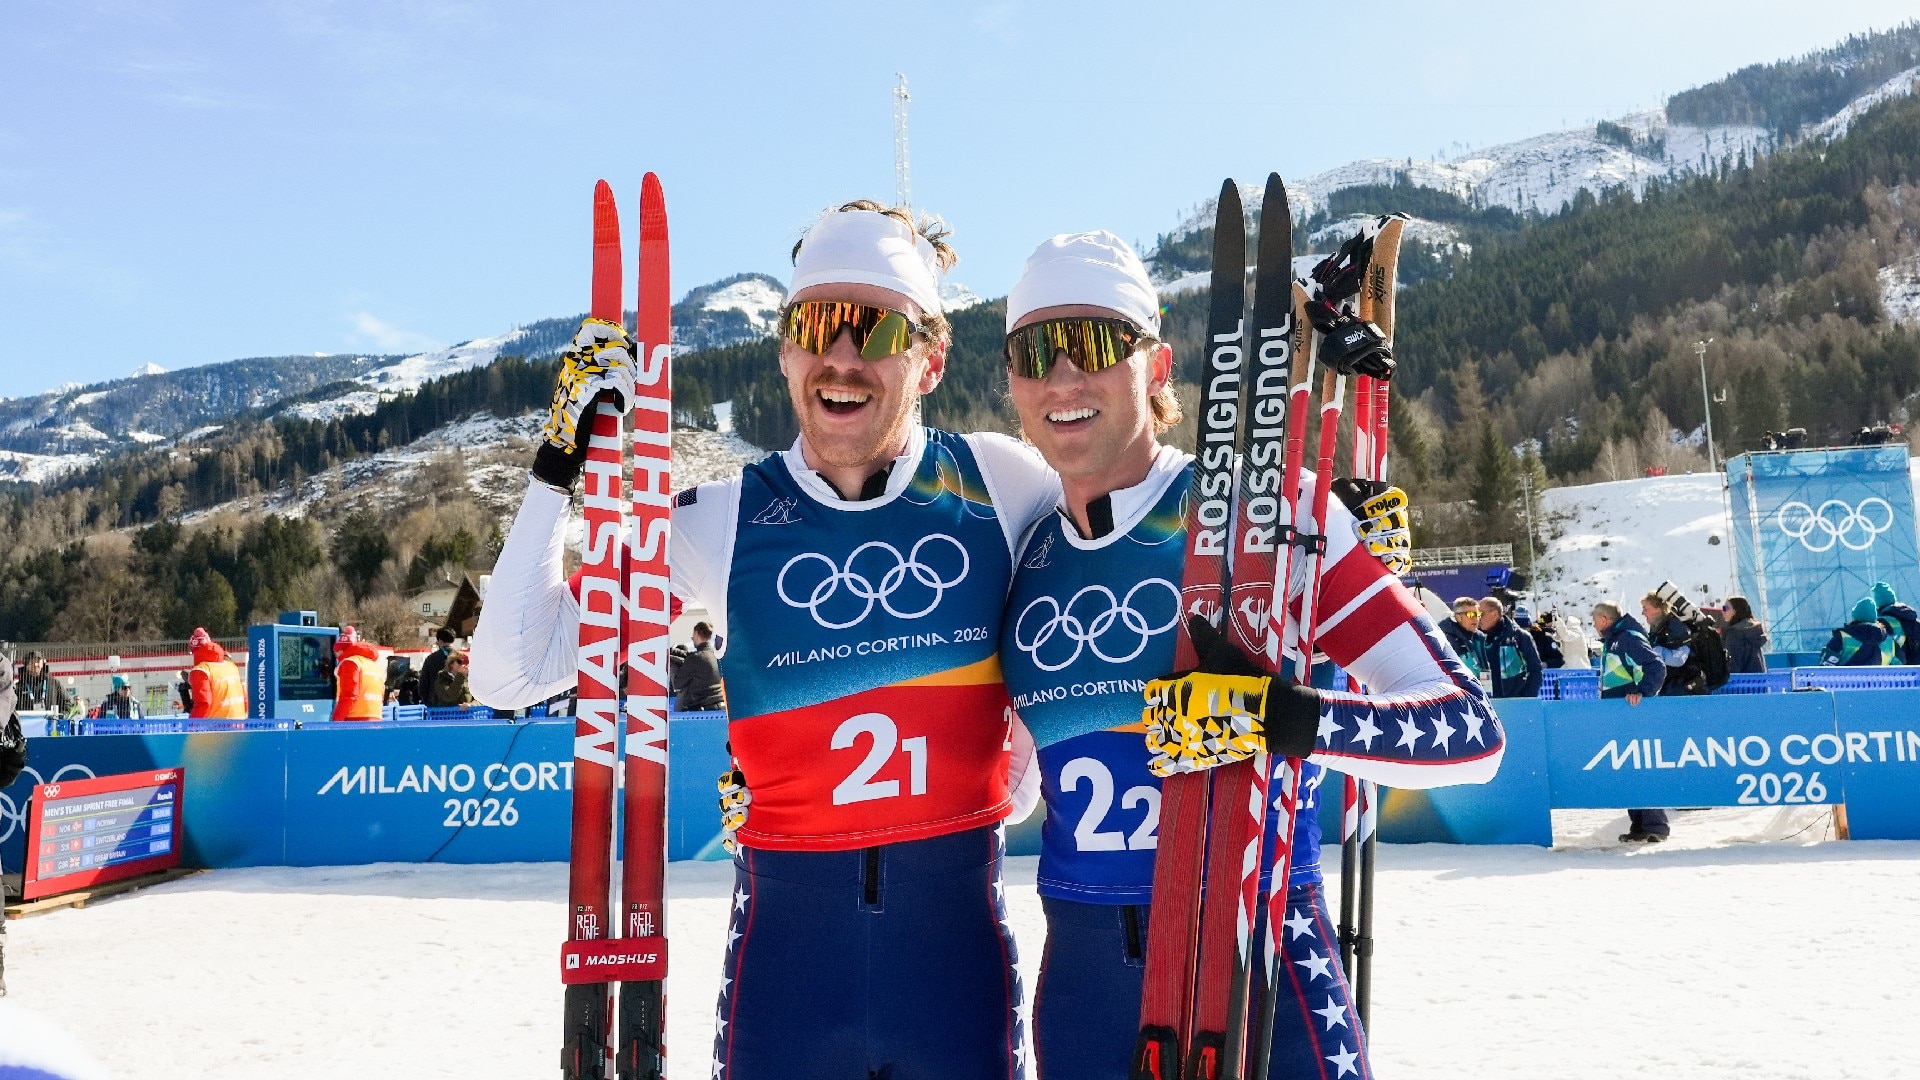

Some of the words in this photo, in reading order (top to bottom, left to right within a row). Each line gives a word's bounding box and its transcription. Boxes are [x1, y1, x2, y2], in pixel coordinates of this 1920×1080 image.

[1193, 318, 1244, 556] ROSSIGNOL
[1243, 312, 1291, 554] ROSSIGNOL
[625, 341, 671, 770] MADSHUS
[573, 401, 623, 770] MADSHU
[257, 638, 266, 658] 2026
[766, 645, 852, 669] MILANO
[856, 633, 949, 656] CORTINA
[953, 626, 988, 643] 2026
[257, 659, 266, 700] CORTINA
[1013, 686, 1067, 711] MILANO
[1071, 679, 1147, 698] CORTINA
[830, 712, 928, 806] 21
[1582, 735, 1770, 771] MILANO
[317, 763, 475, 795] MILANO
[483, 762, 626, 791] CORT
[1736, 771, 1827, 805] 2026
[44, 806, 65, 818] MEN'S
[65, 803, 82, 815] TEAM
[83, 801, 104, 812] SPRINT
[104, 799, 118, 809] FREE
[118, 797, 134, 806] FINAL
[443, 798, 519, 827] 2026
[1059, 757, 1162, 852] 22
[576, 914, 597, 928] RED
[630, 912, 652, 926] RED
[585, 953, 657, 966] MADSHUS
